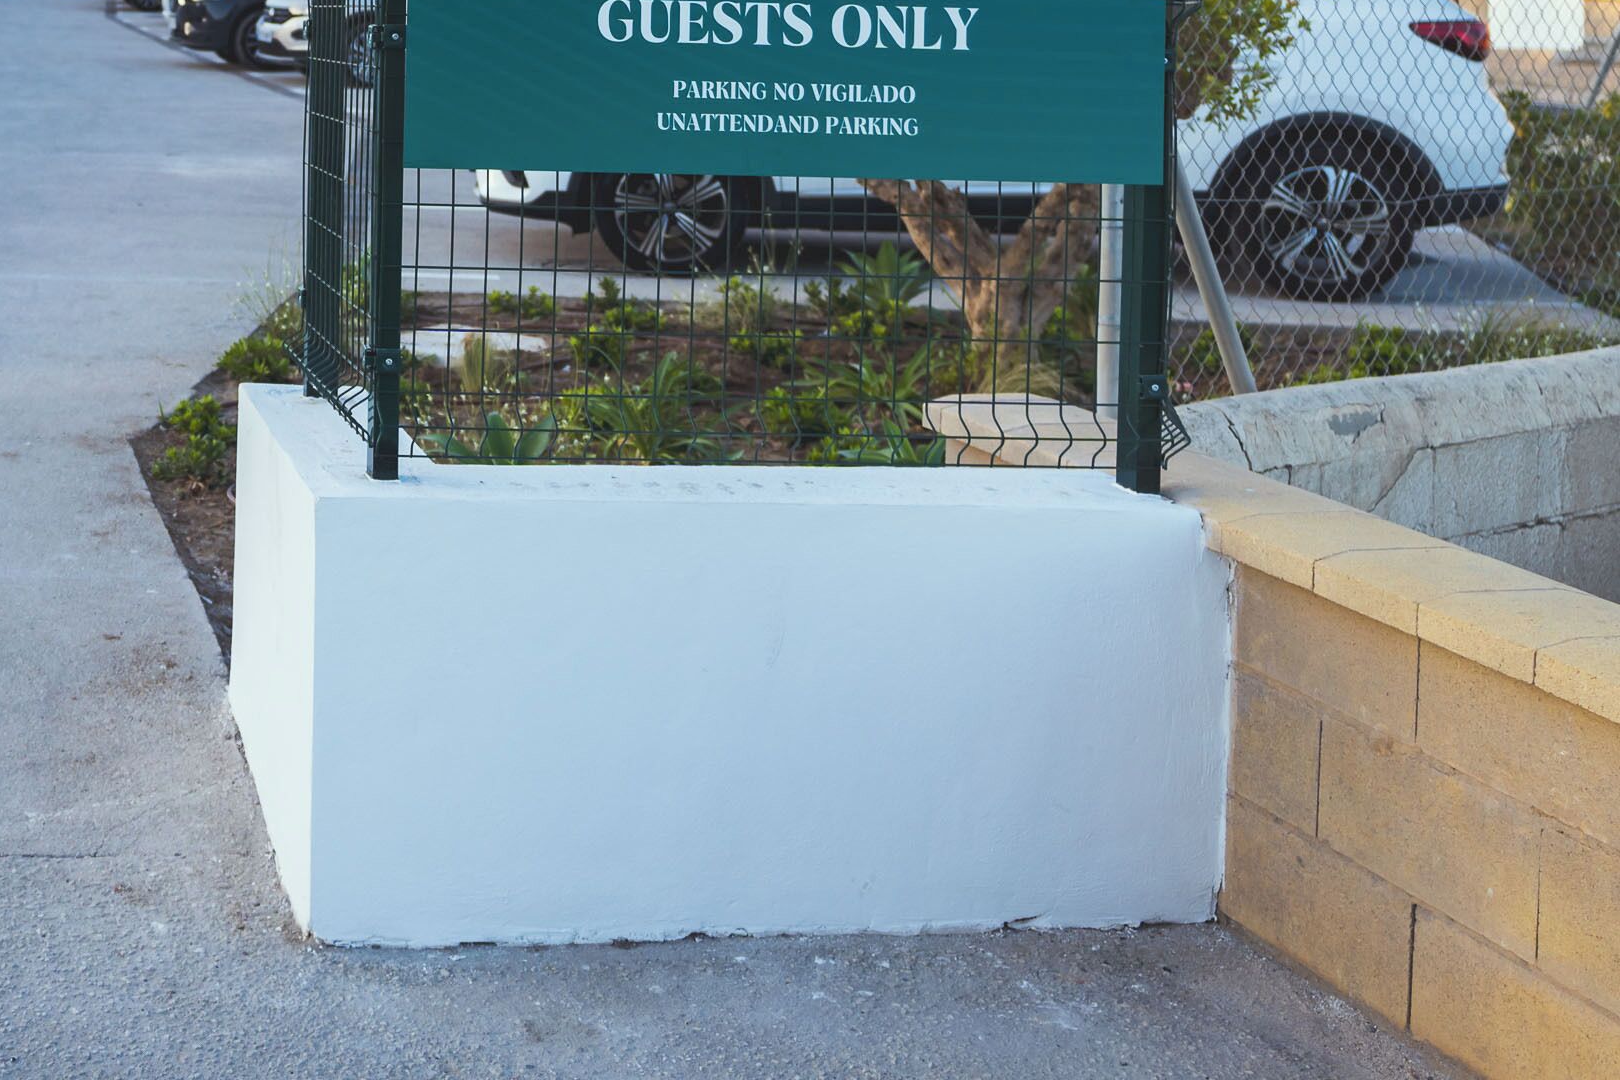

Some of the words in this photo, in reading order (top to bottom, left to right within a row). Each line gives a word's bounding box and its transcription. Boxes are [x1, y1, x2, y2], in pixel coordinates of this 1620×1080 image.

[831, 4, 979, 51] ONLY
[673, 80, 767, 100] PARKING
[773, 82, 805, 101] NO
[810, 83, 916, 104] VIGILADO
[657, 112, 819, 134] UNATTENDAND
[825, 116, 919, 136] PARKING
